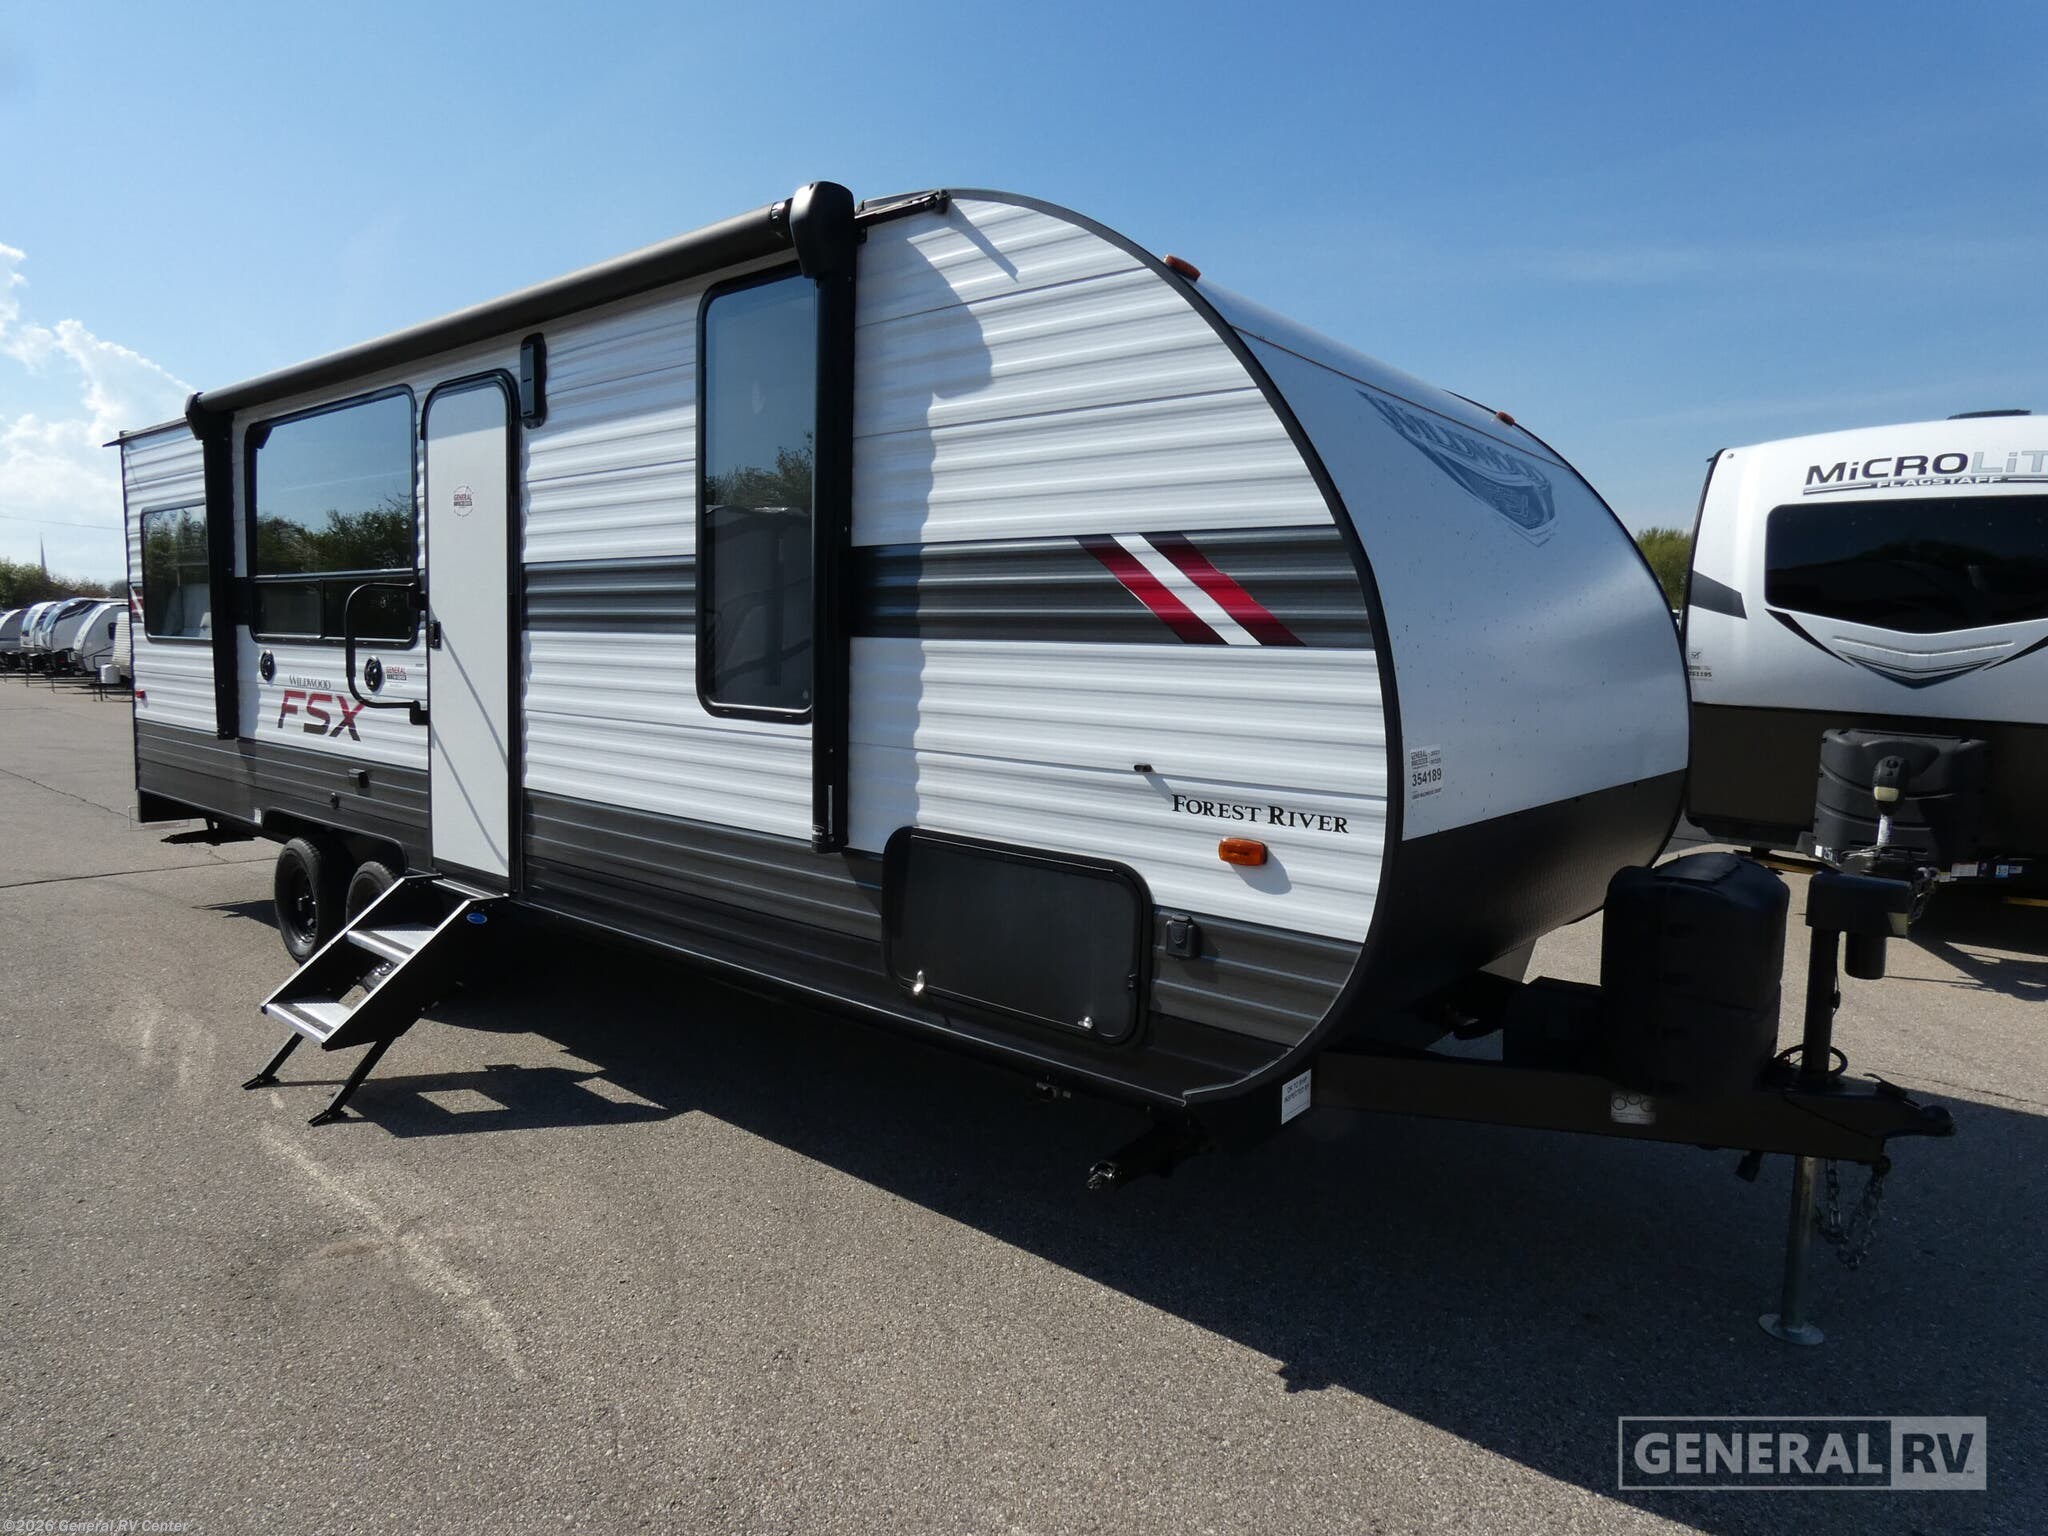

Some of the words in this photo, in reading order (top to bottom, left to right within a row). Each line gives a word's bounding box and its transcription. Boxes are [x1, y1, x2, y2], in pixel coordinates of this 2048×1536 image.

[1876, 475, 2003, 489] FLAGSTAFF
[289, 674, 332, 690] WILDWOOD
[277, 690, 367, 742] FSX
[1412, 767, 1442, 787] 354189
[1172, 794, 1262, 823] FOREST
[1268, 805, 1349, 834] RIVER
